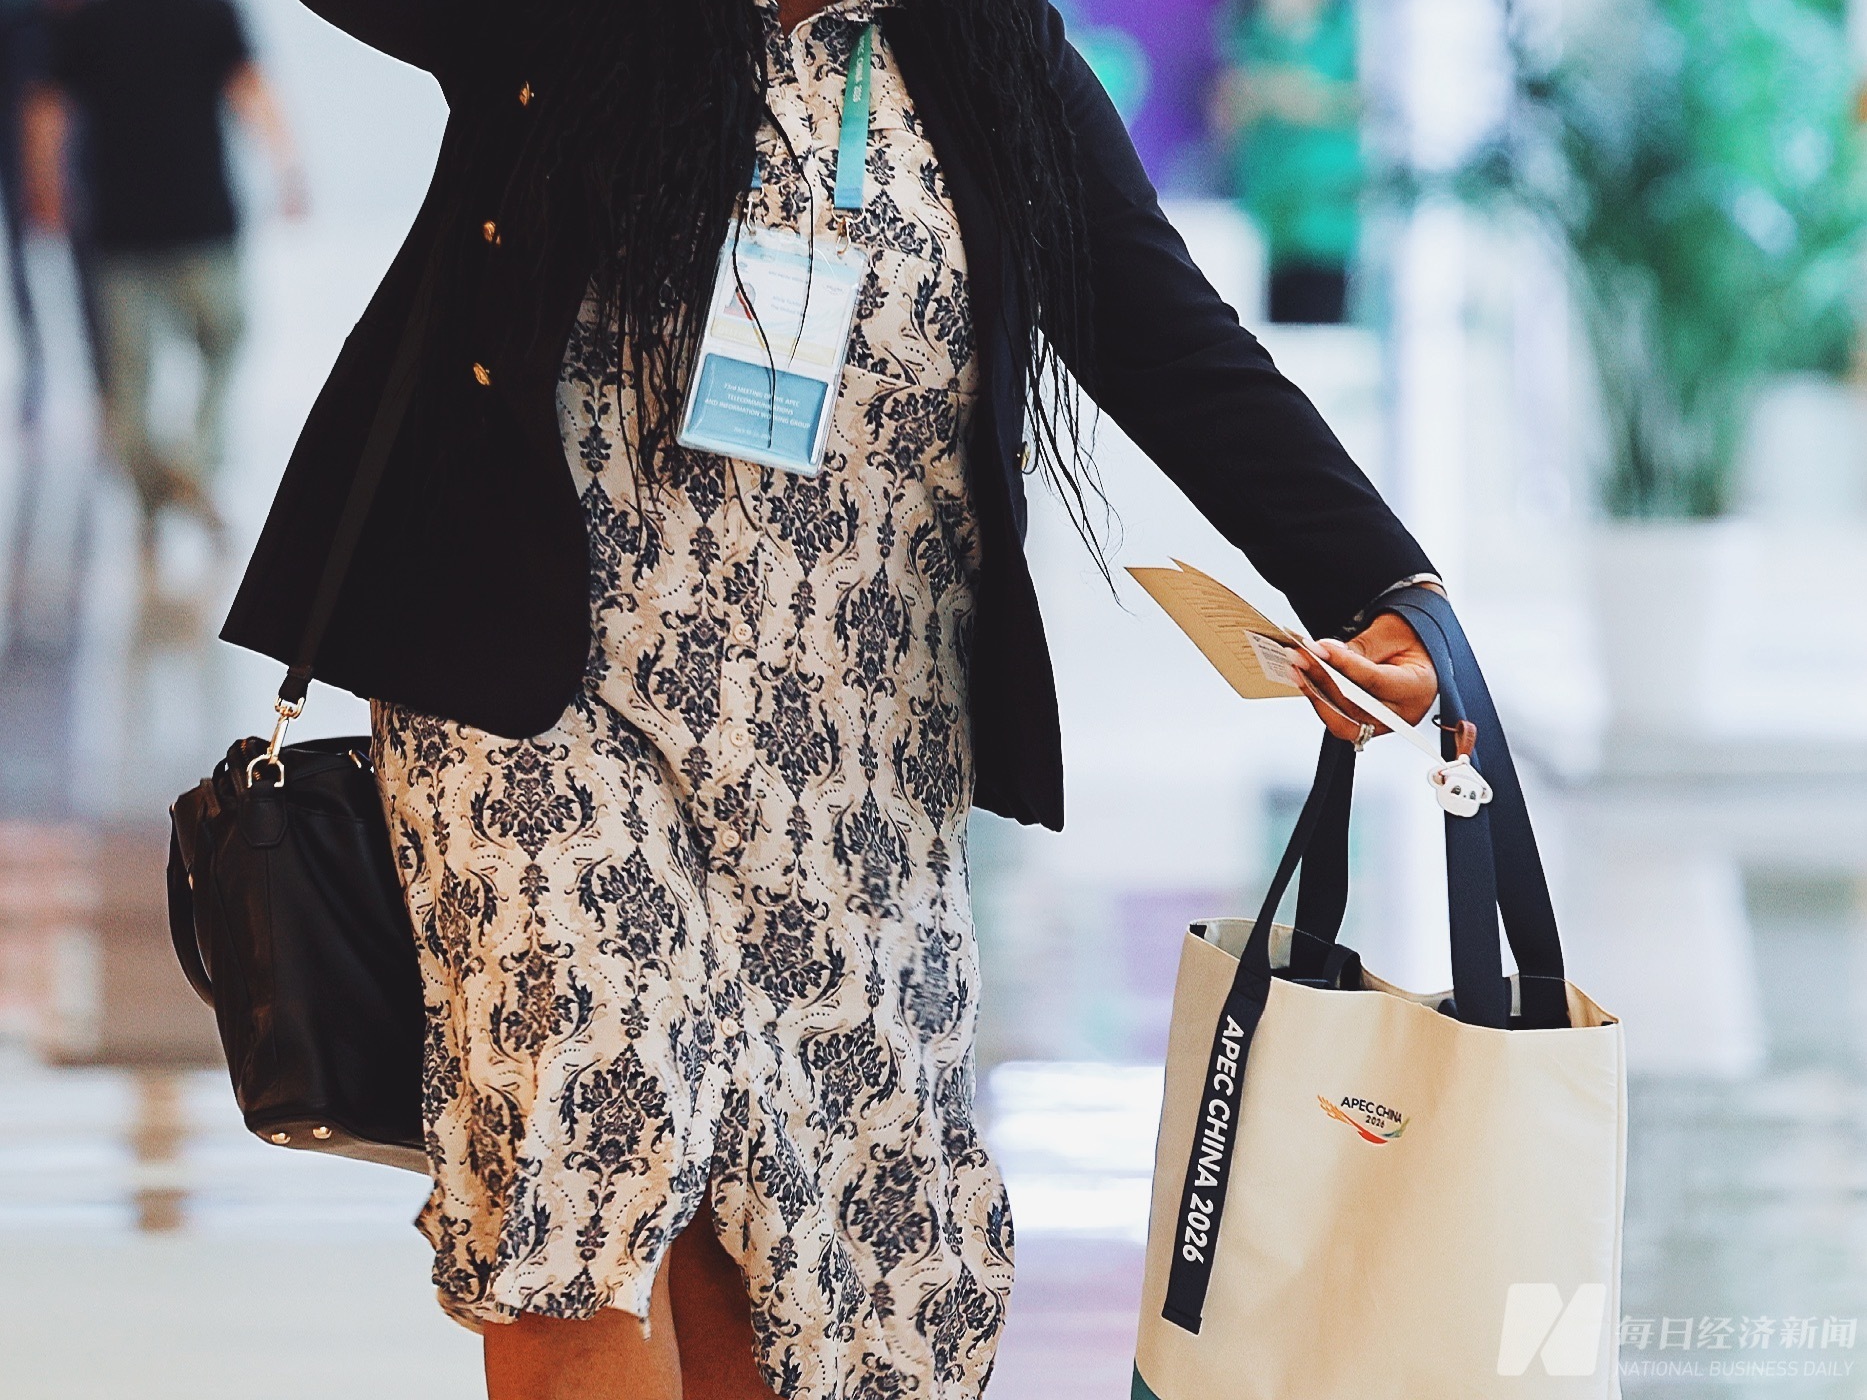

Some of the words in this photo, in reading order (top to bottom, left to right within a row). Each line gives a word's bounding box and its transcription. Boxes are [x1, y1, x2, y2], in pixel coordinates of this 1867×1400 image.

[1212, 1015, 1245, 1097] APEC
[1194, 1099, 1231, 1187] CHINA
[1341, 1096, 1375, 1114] APEC
[1376, 1104, 1402, 1124] CHINA
[1365, 1114, 1386, 1129] 2026
[1183, 1193, 1214, 1264] 2026
